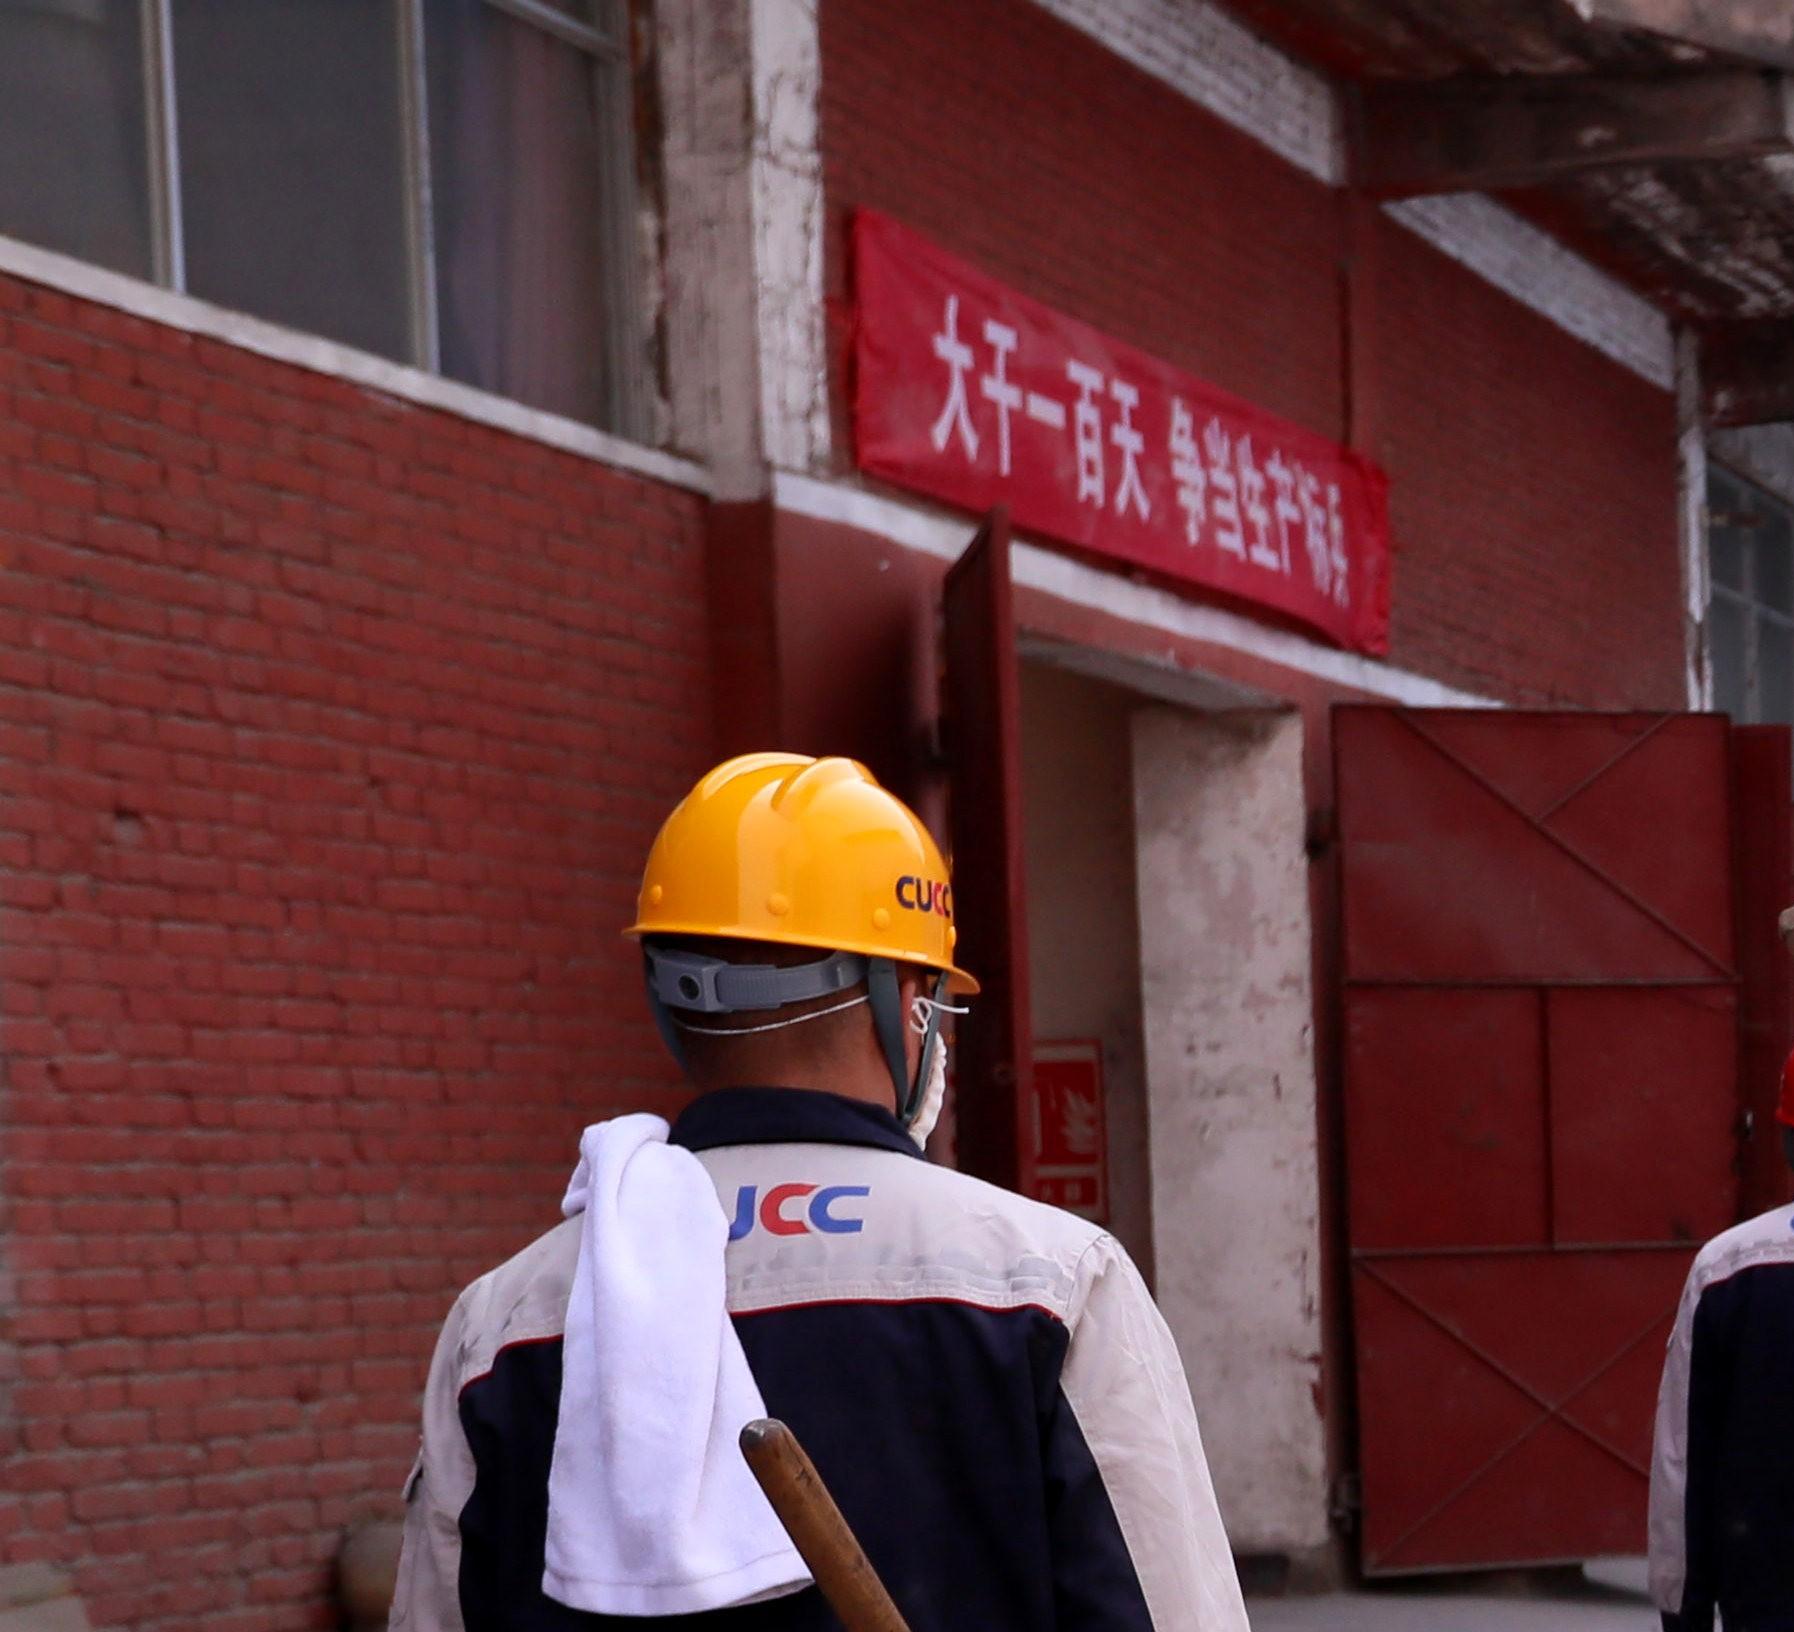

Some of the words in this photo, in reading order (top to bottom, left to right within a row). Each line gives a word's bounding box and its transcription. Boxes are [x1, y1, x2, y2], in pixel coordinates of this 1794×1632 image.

[930, 294, 1151, 522] 大干一百天
[896, 875, 952, 918] CUCC
